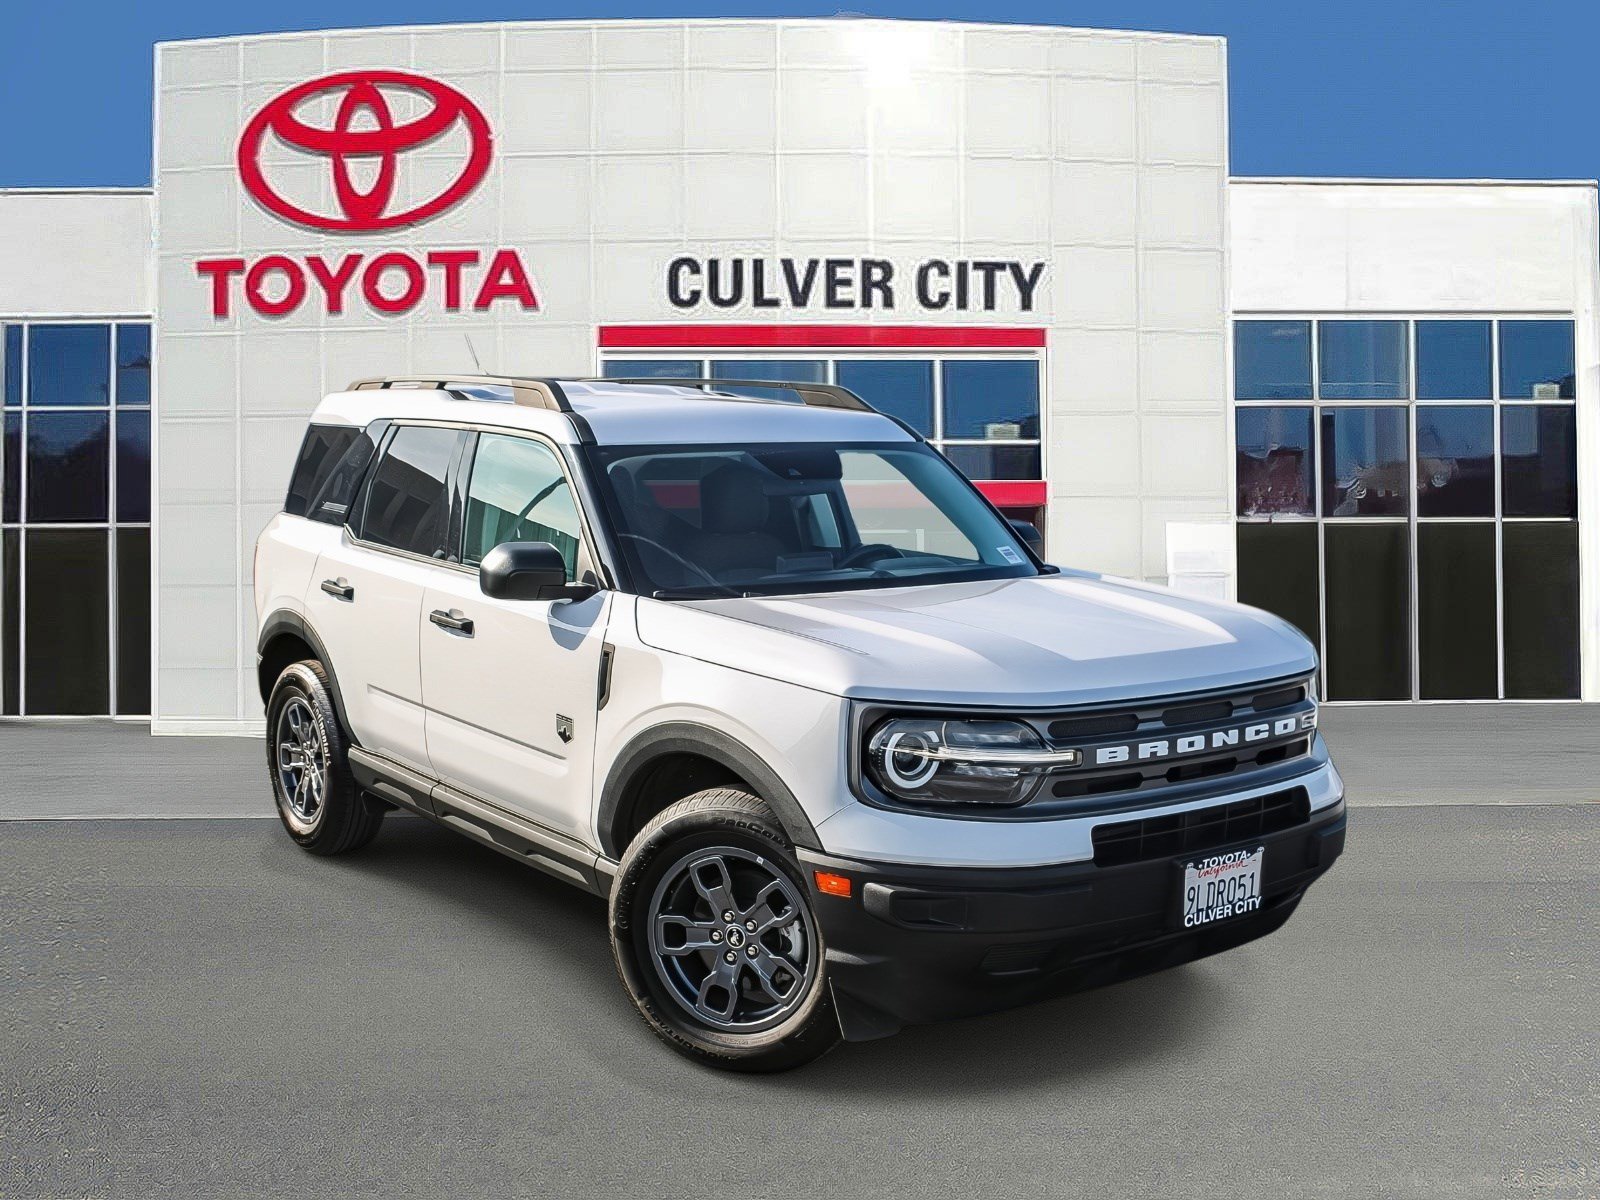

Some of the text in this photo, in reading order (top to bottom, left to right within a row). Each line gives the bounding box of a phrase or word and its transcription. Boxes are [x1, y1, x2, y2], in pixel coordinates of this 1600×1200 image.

[196, 249, 538, 319] TOYOTA
[667, 257, 1046, 312] CULVER CITY
[1096, 717, 1297, 764] BRONCO
[1202, 850, 1248, 869] TOYOTA
[1184, 896, 1262, 927] CULVER CITY
[1187, 871, 1257, 914] 9LDR051
